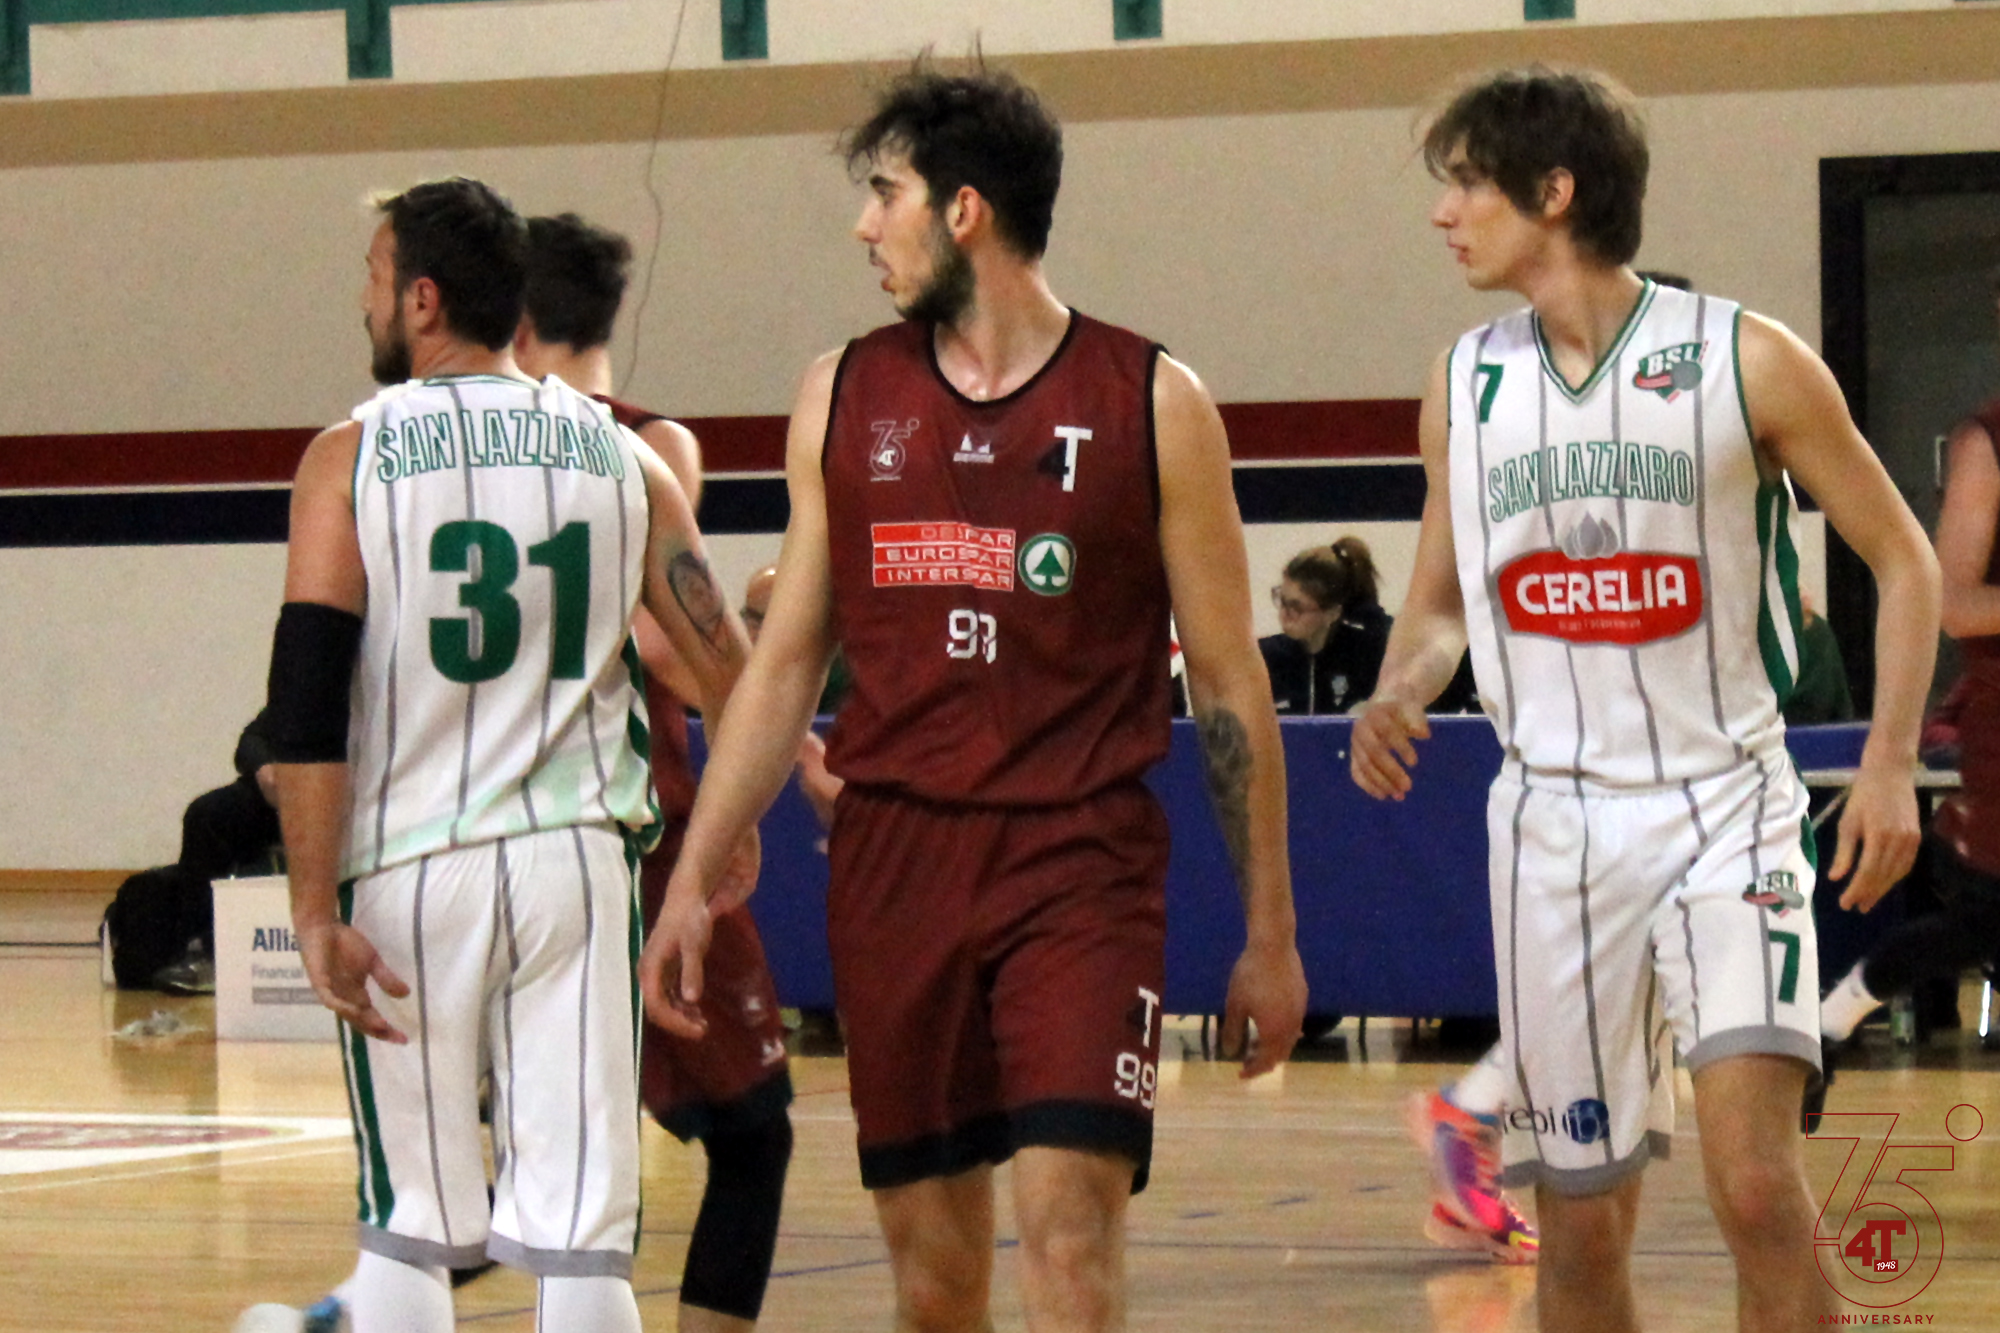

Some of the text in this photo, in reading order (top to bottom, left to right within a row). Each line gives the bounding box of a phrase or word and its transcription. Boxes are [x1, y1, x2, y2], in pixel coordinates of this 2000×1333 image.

[1476, 363, 1505, 424] 7
[376, 408, 625, 483] SAN LAZZARO
[1488, 440, 1695, 523] SAN LAZZARO
[429, 519, 590, 683] 31
[1516, 565, 1688, 615] CERELIA
[1768, 929, 1800, 1004] 7
